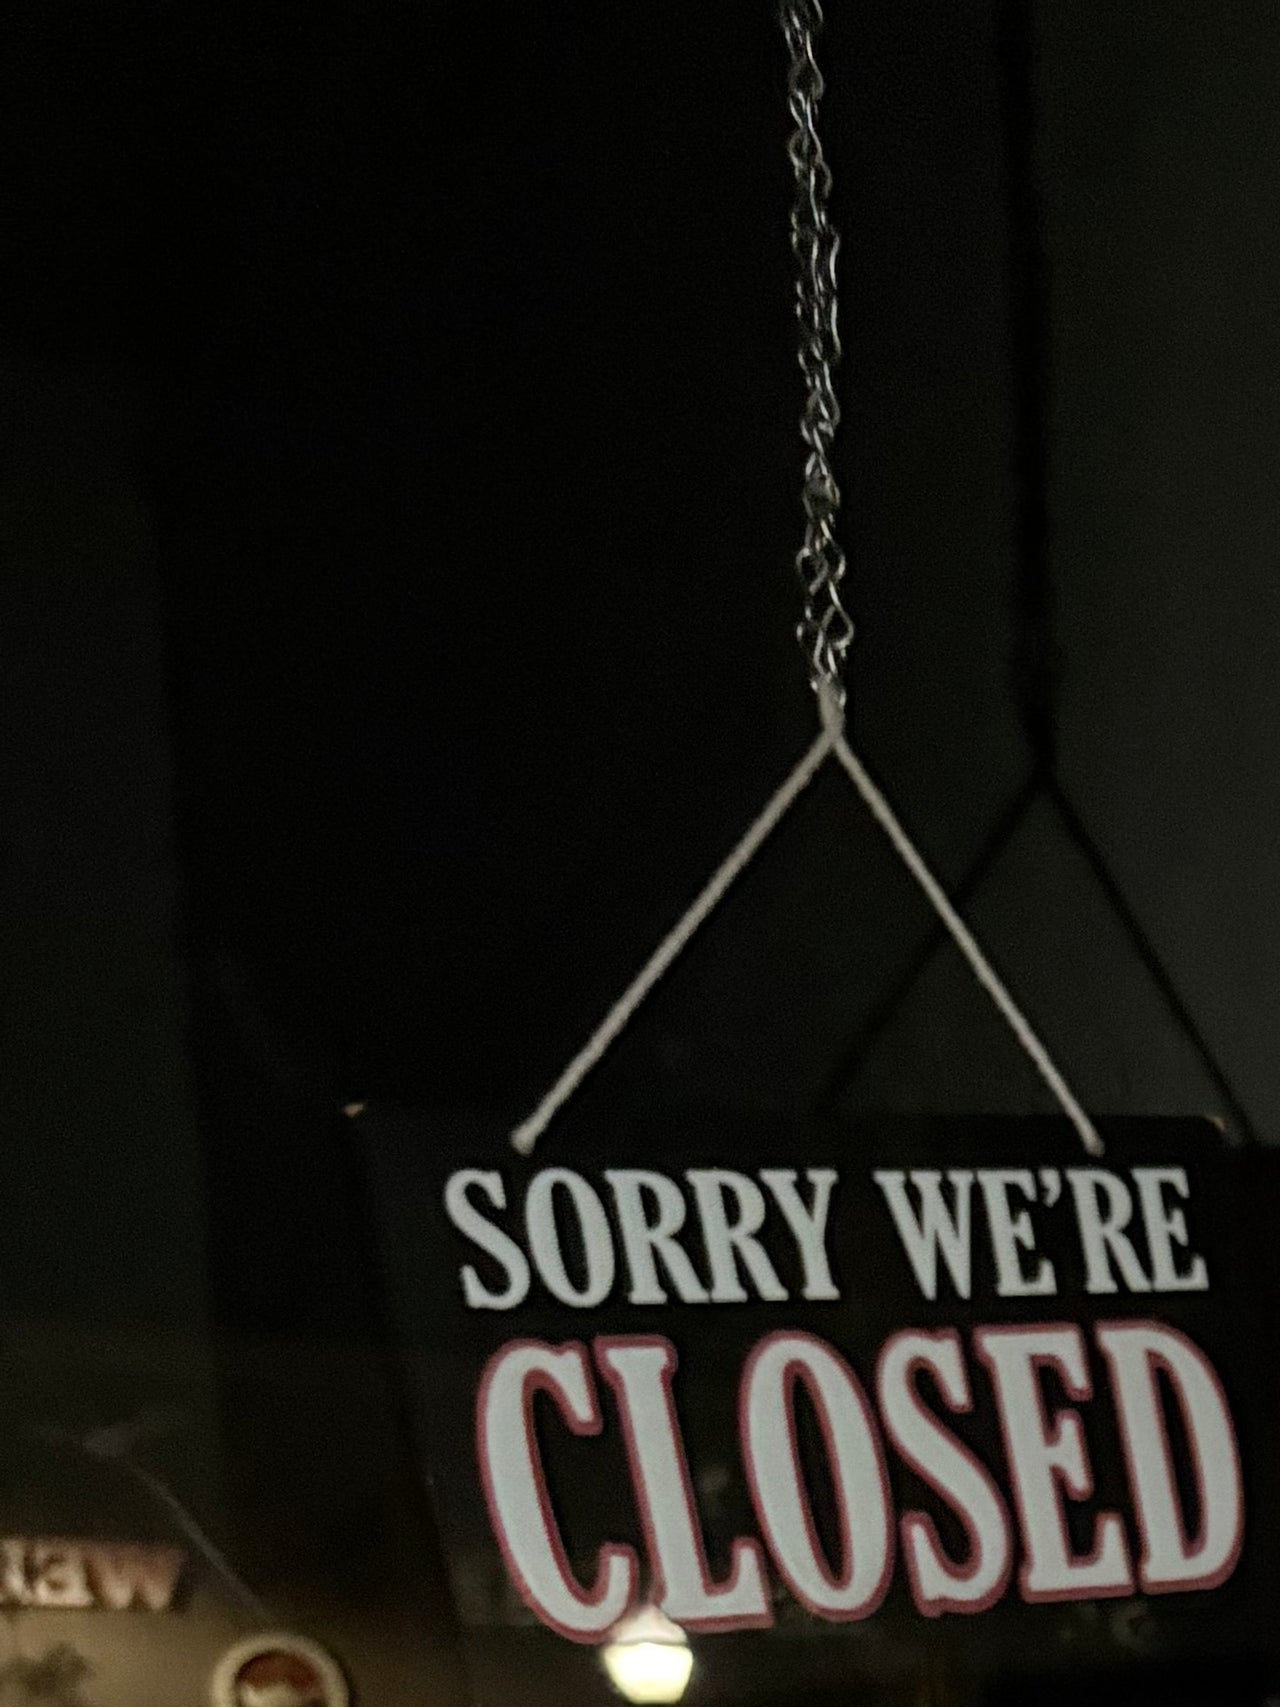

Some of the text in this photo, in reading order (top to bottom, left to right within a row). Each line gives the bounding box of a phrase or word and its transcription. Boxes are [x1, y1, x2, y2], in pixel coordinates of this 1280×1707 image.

[442, 1165, 1211, 1312] SORRY WE'RE
[475, 1317, 1247, 1643] CLOSED
